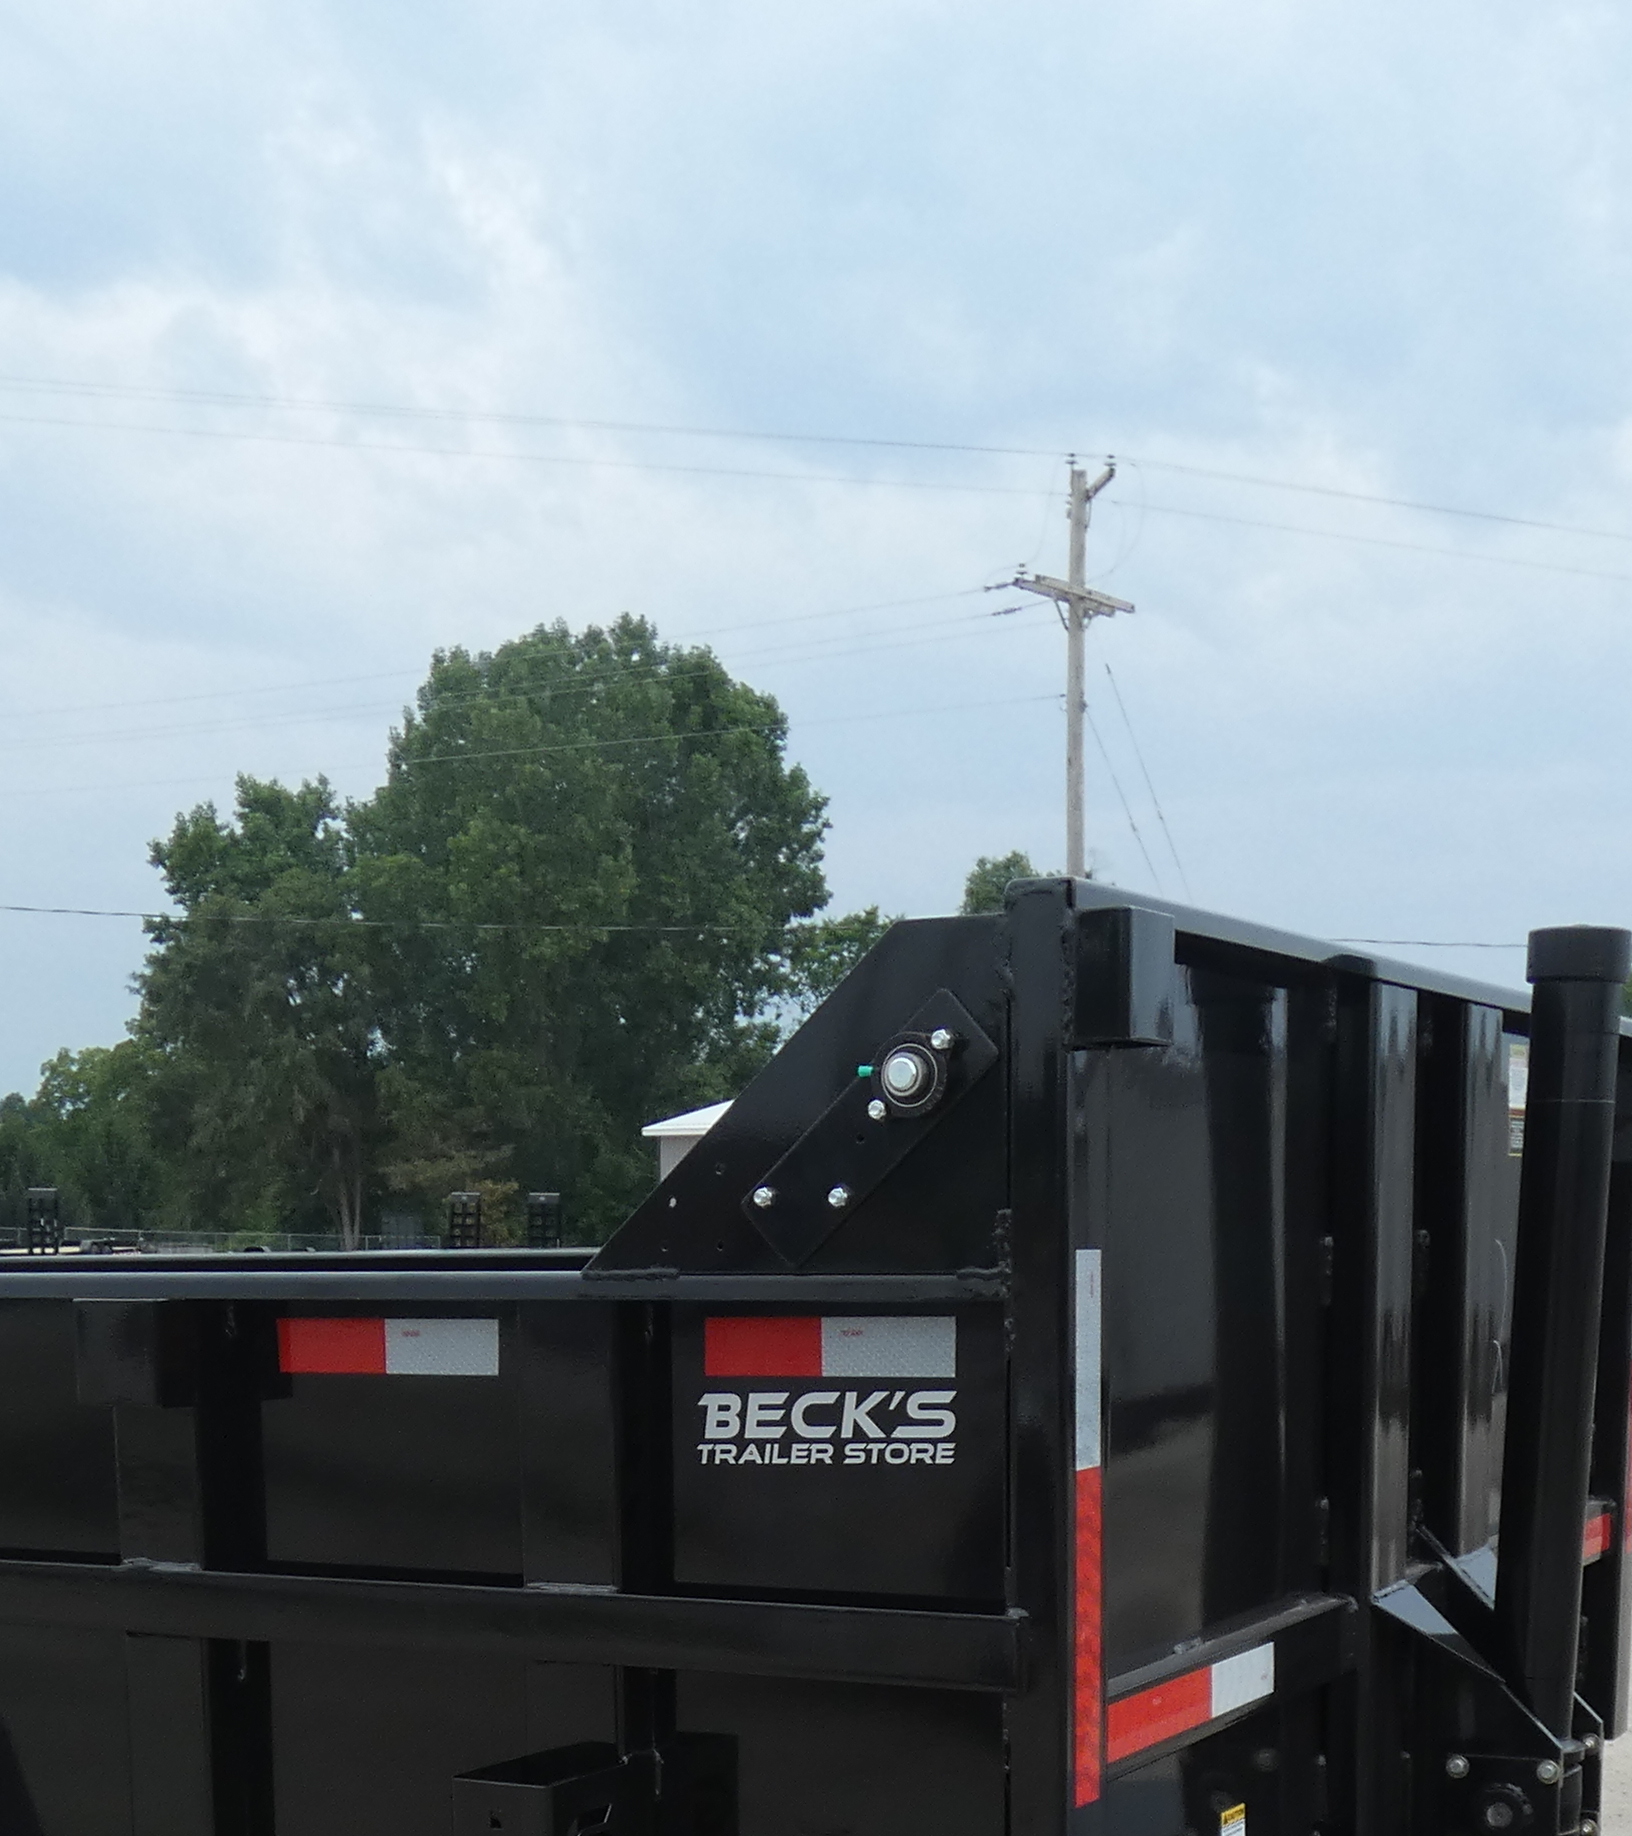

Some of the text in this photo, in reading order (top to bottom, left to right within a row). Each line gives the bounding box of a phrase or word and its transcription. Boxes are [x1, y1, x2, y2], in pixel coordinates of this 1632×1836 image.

[697, 1390, 957, 1439] BECK'S
[697, 1442, 957, 1465] TRAILER STORE
